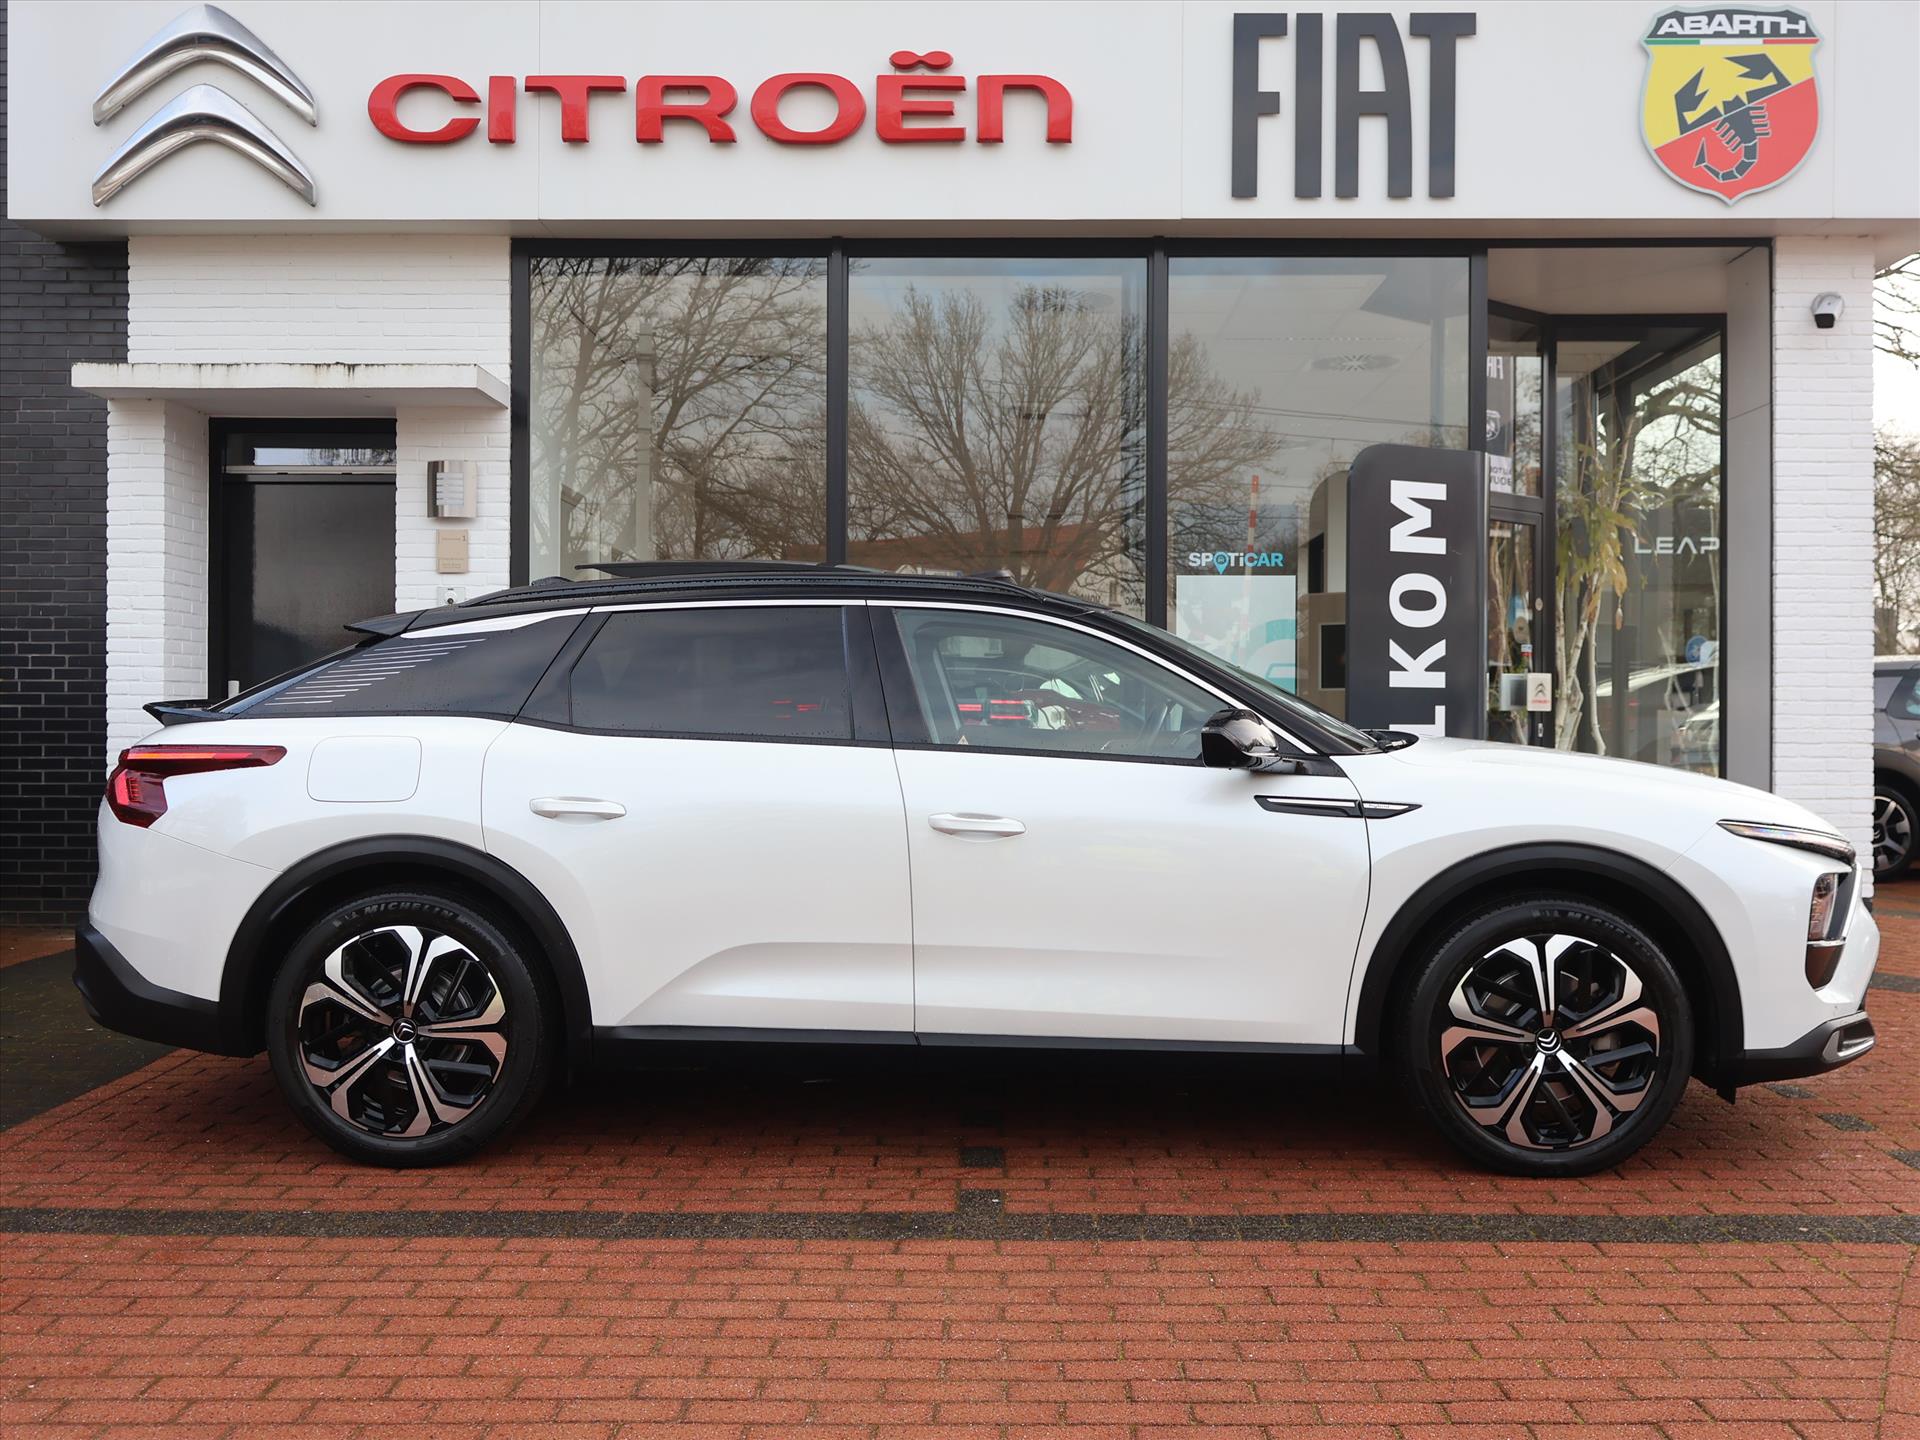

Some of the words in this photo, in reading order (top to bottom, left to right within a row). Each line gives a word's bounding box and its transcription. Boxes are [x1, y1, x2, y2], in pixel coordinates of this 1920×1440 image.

[1656, 13, 1807, 36] ABARTH
[367, 50, 1072, 146] CITROËN
[1232, 13, 1477, 199] FIAT
[1634, 536, 1720, 555] LEAP
[364, 902, 455, 918] MICHELIN
